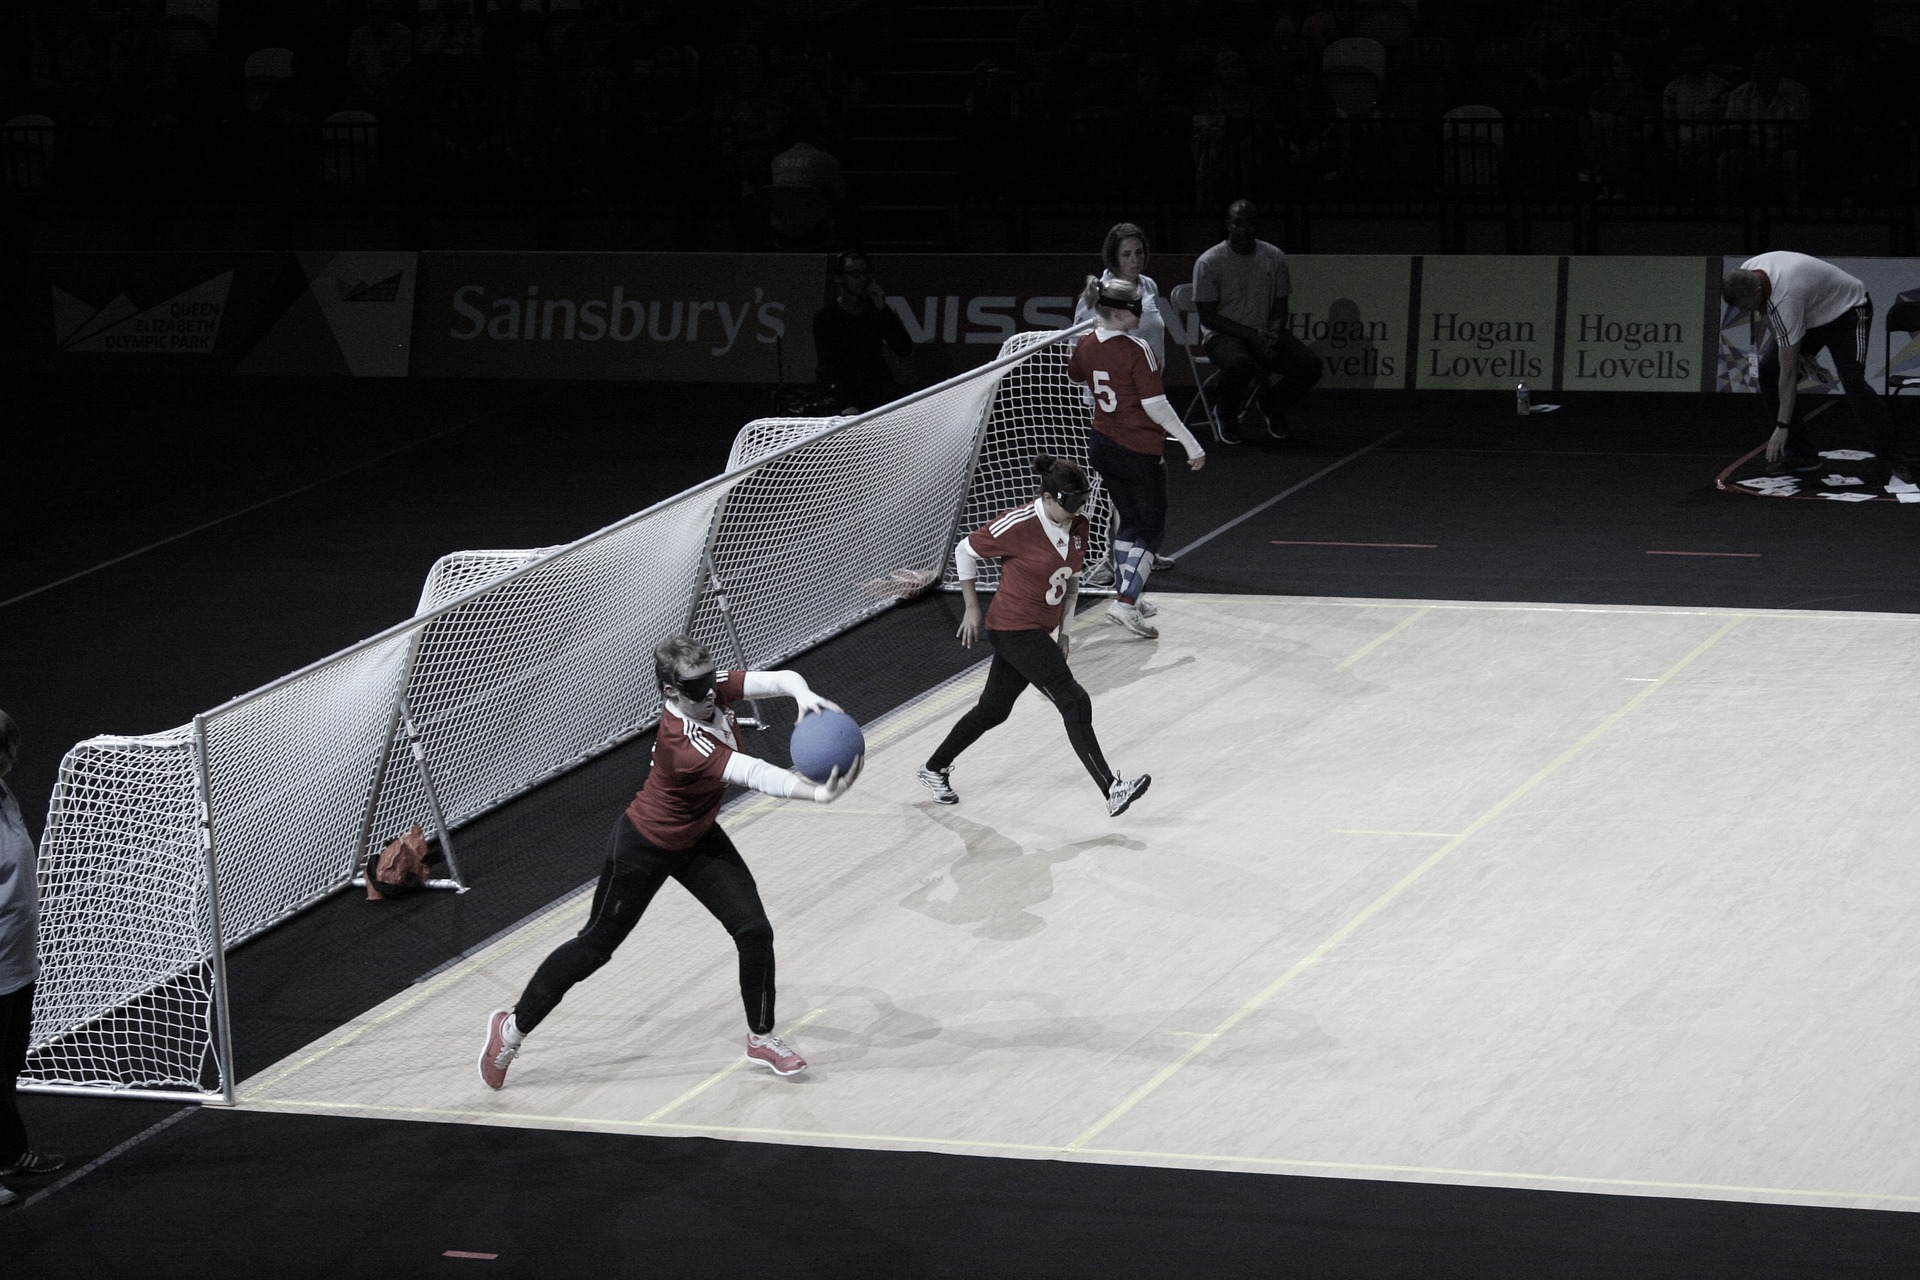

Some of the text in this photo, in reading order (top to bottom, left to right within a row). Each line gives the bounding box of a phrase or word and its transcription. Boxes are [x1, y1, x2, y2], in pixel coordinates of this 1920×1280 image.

[136, 320, 215, 333] ELIZABETH
[170, 303, 220, 317] QUEEN
[449, 284, 786, 357] Sainsbury's
[884, 295, 1200, 345] NISSN
[105, 335, 210, 349] OLYMPIC PARK
[1288, 312, 1389, 349] Hogan
[1430, 313, 1537, 350] Hogan
[1577, 314, 1684, 351] Hogan
[1325, 349, 1395, 377] vells
[1429, 349, 1542, 378] Lovells
[1576, 350, 1690, 379] Lovells
[1092, 370, 1118, 413] 5
[1045, 566, 1073, 606] 8
